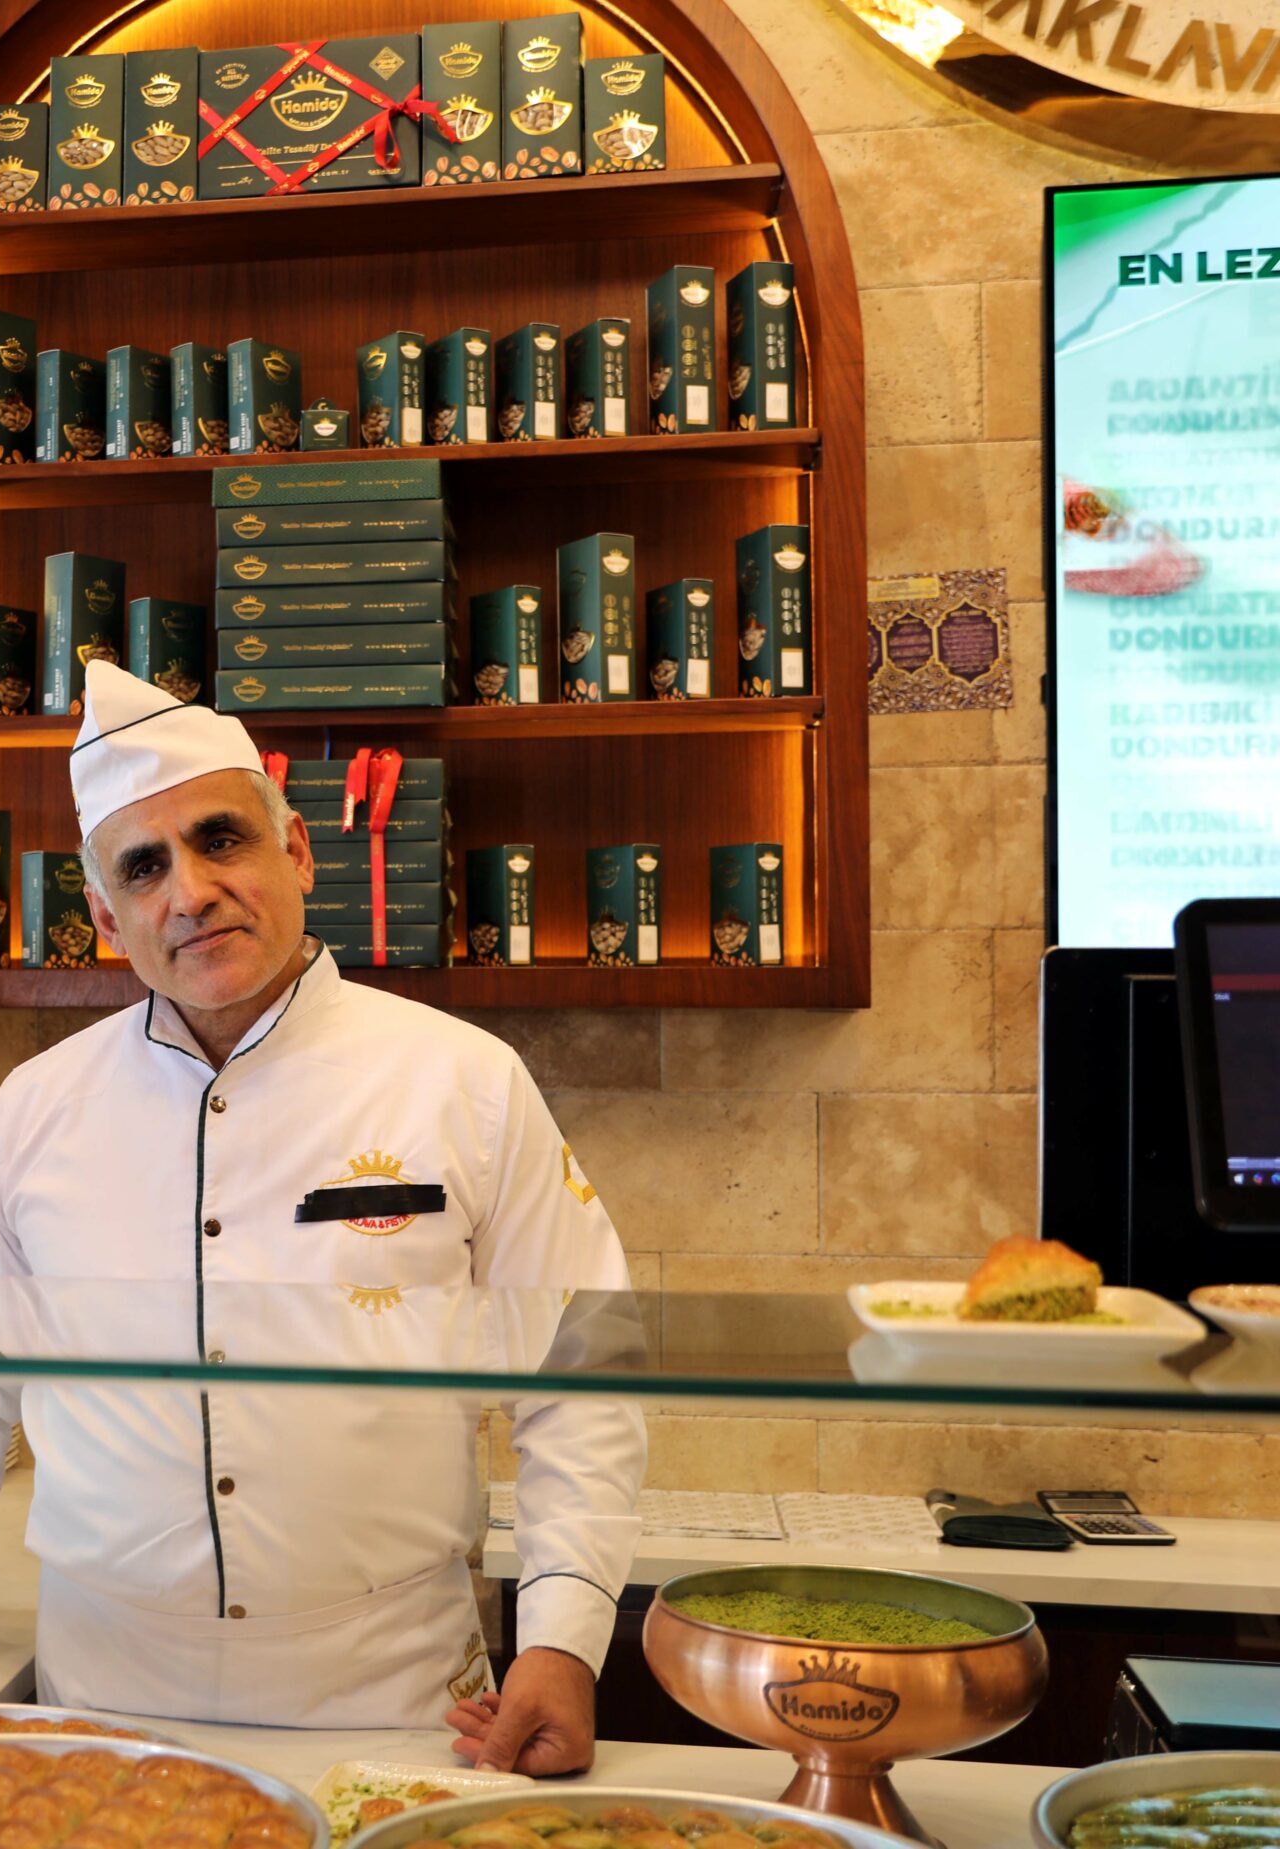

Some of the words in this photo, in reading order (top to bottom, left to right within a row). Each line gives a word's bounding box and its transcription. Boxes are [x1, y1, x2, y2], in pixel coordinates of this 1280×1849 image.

[281, 97, 337, 114] Hamido
[1119, 254, 1182, 286] EN
[1197, 247, 1280, 282] LEZ
[780, 1693, 884, 1722] Hamido
